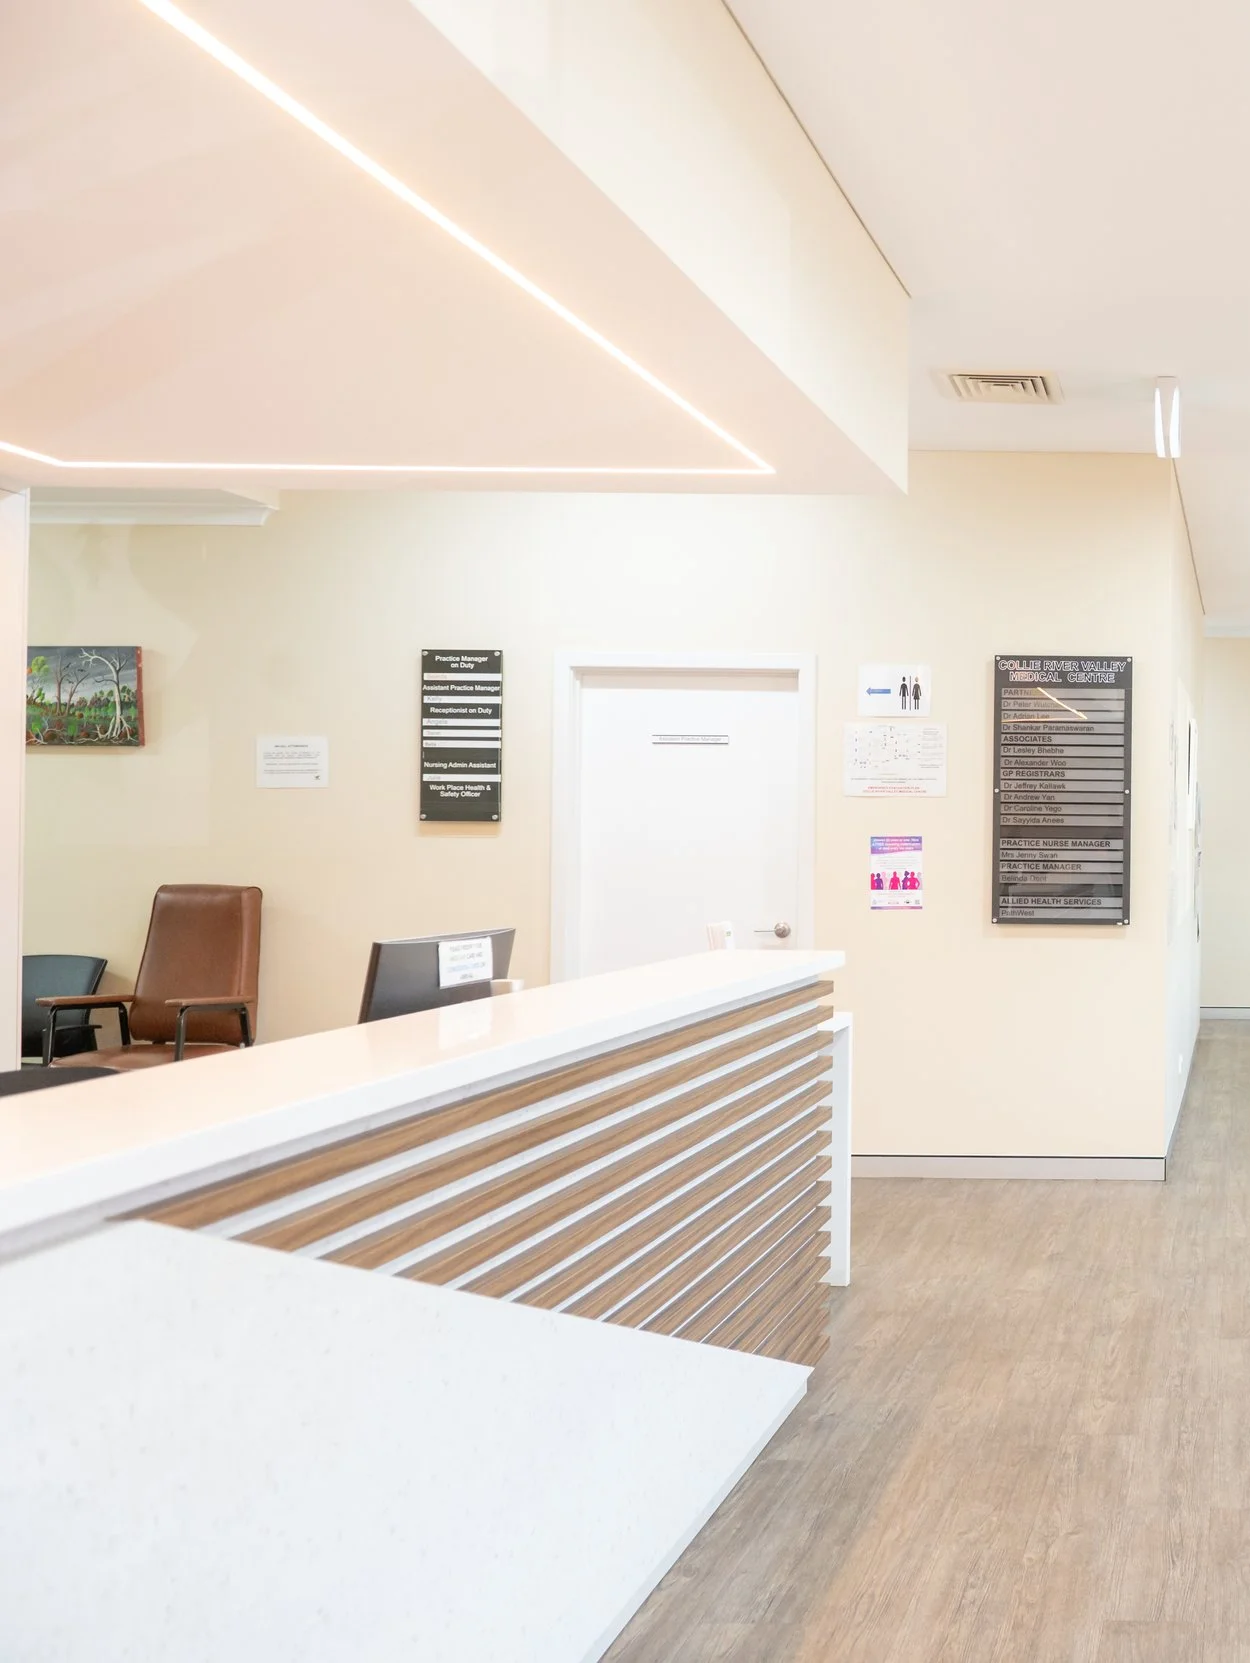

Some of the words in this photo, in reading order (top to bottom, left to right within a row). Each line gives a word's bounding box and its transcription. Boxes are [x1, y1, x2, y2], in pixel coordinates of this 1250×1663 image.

[461, 655, 489, 663] Manager
[460, 662, 475, 670] Duty
[998, 660, 1041, 671] COLLIE
[1043, 660, 1079, 671] RIVER
[1081, 661, 1127, 672] VALLEY
[1009, 671, 1062, 683] MEDICAL
[1067, 672, 1115, 683] CENTRE
[475, 685, 501, 693] Manager
[430, 706, 468, 715] Receptionist
[478, 707, 492, 715] Duty
[1013, 747, 1036, 755] Lesley
[424, 761, 448, 770] Nursing
[448, 761, 468, 769] Admin
[468, 761, 497, 769] Assistant
[1015, 770, 1066, 778] REGISTRARS
[1013, 782, 1037, 791] Jeffrey
[1044, 806, 1062, 814] Yego
[1012, 817, 1040, 825] Sayyida
[1001, 839, 1040, 847] PRACTICE
[1071, 840, 1111, 848] MANAGER
[1016, 852, 1037, 860] Jenny
[1042, 863, 1082, 871] MANAGER
[1063, 898, 1102, 906] SERVICES
